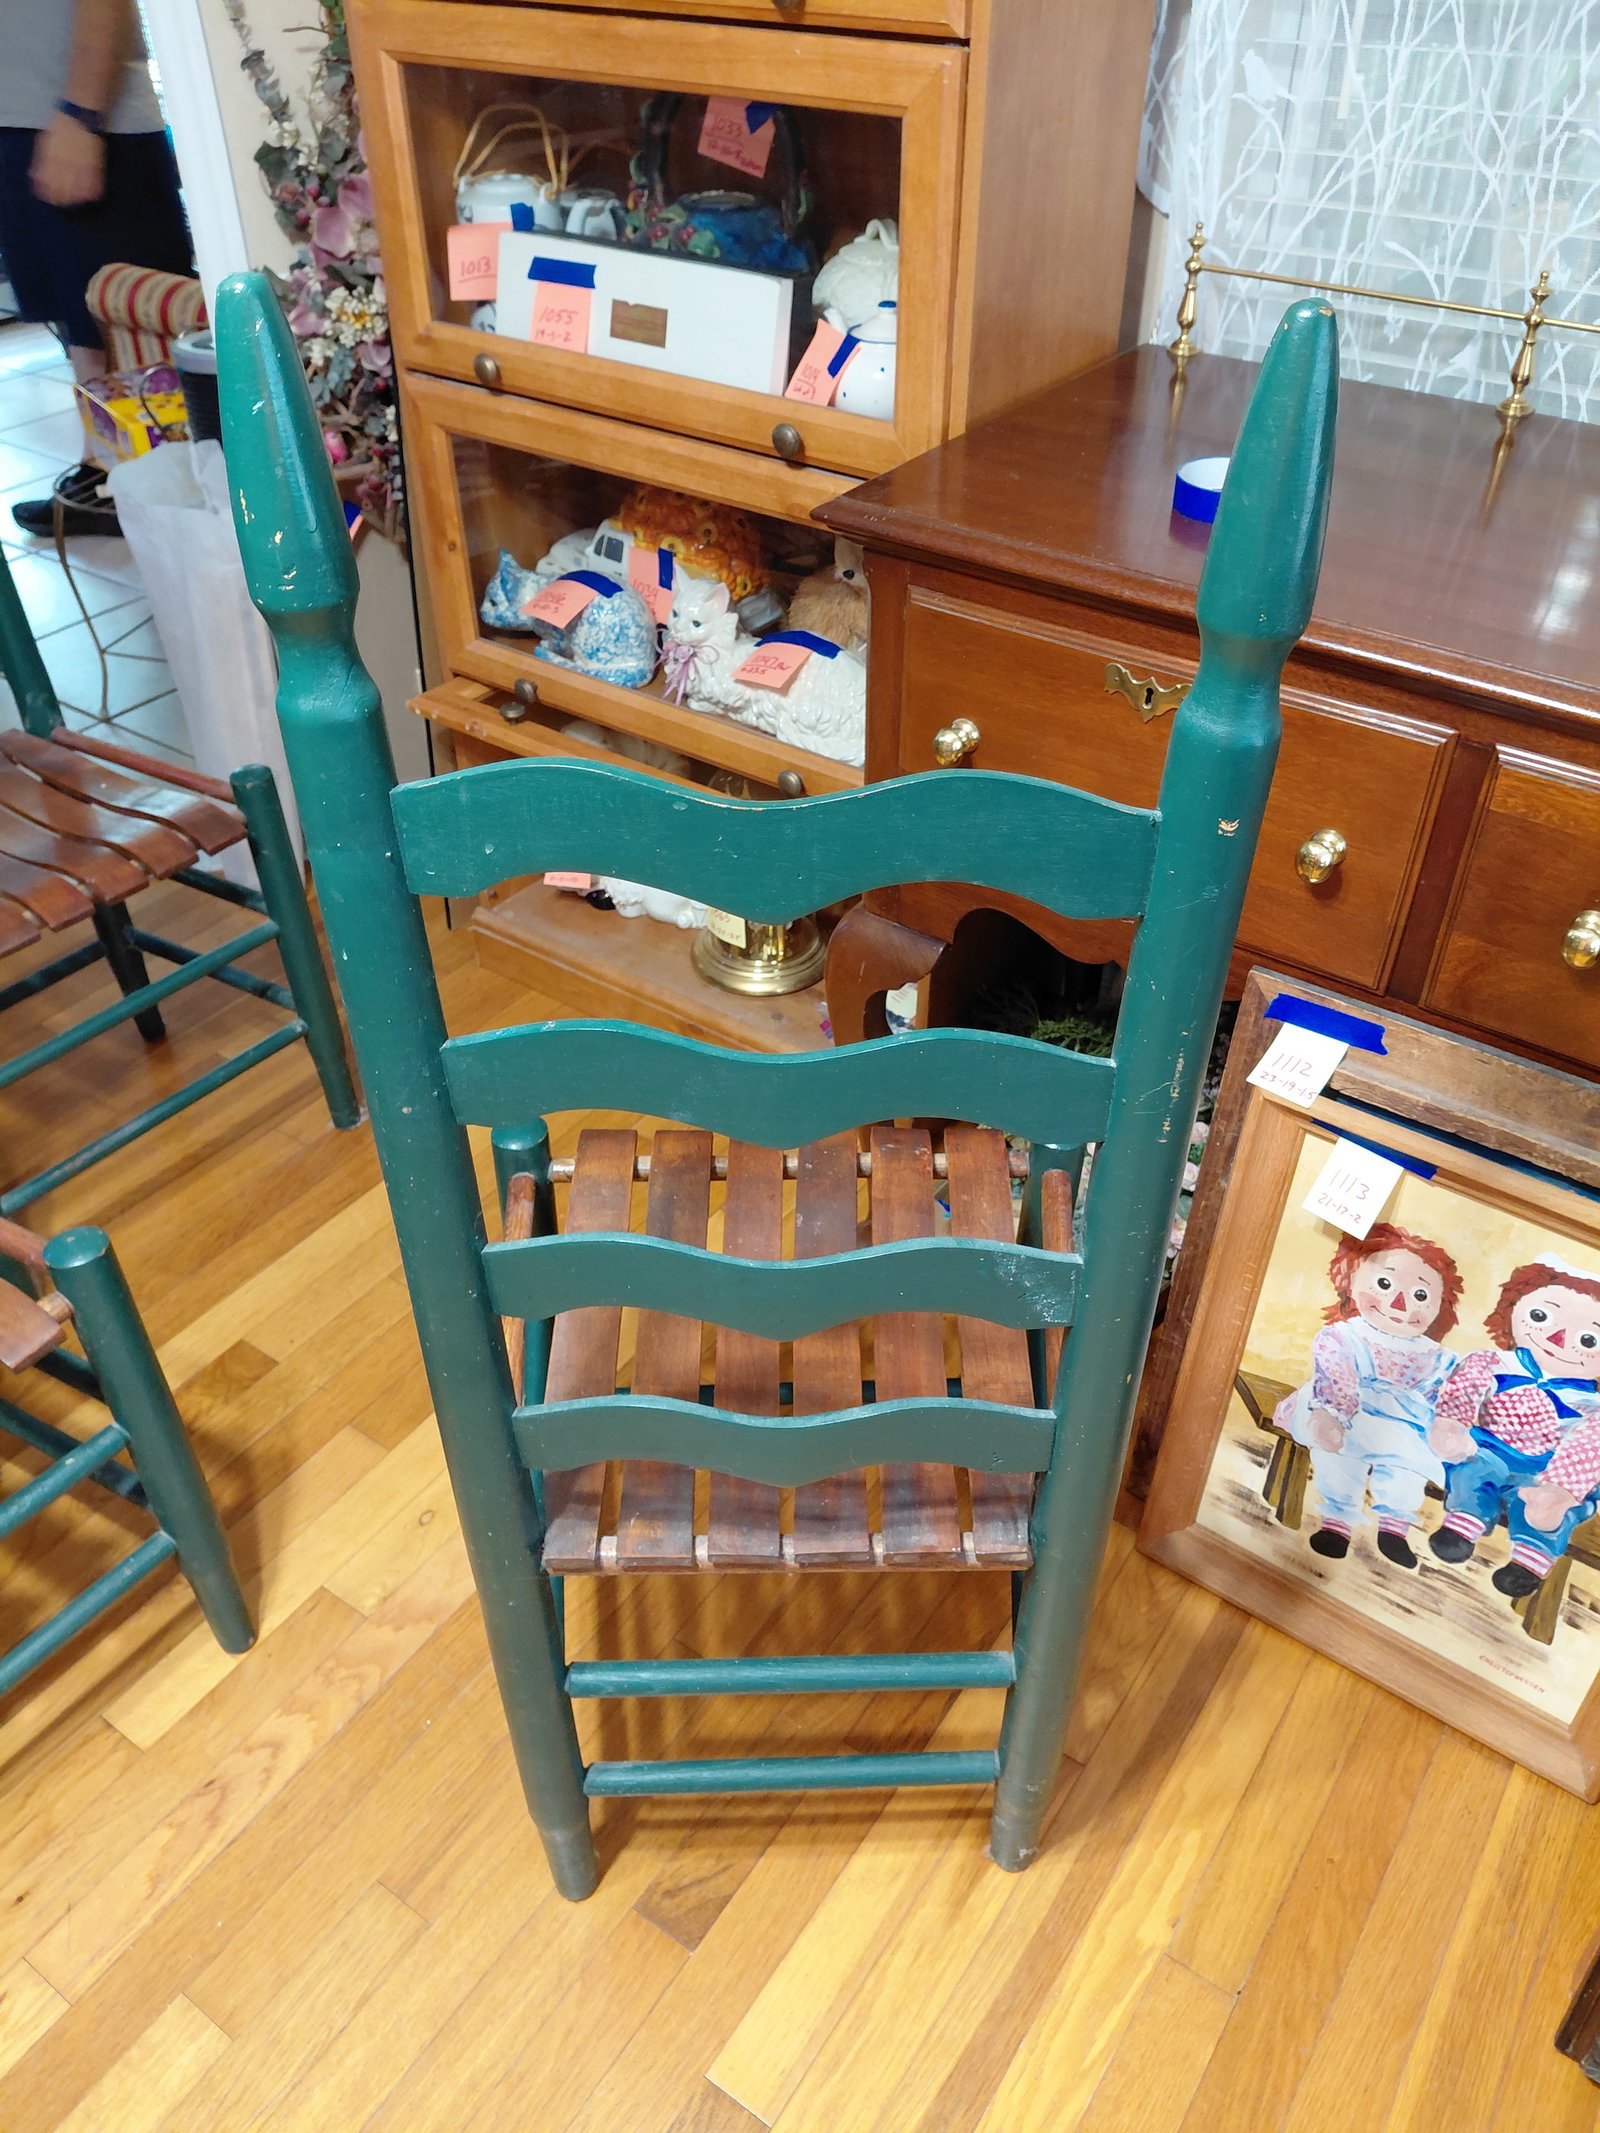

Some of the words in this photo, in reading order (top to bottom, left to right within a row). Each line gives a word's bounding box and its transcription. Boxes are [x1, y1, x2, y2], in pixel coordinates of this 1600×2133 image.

[461, 257, 491, 277] 1013
[541, 307, 578, 325] 1055
[1272, 1053, 1313, 1077] 1112
[1330, 1169, 1370, 1200] 1113
[1318, 1192, 1361, 1224] 21-17-2
